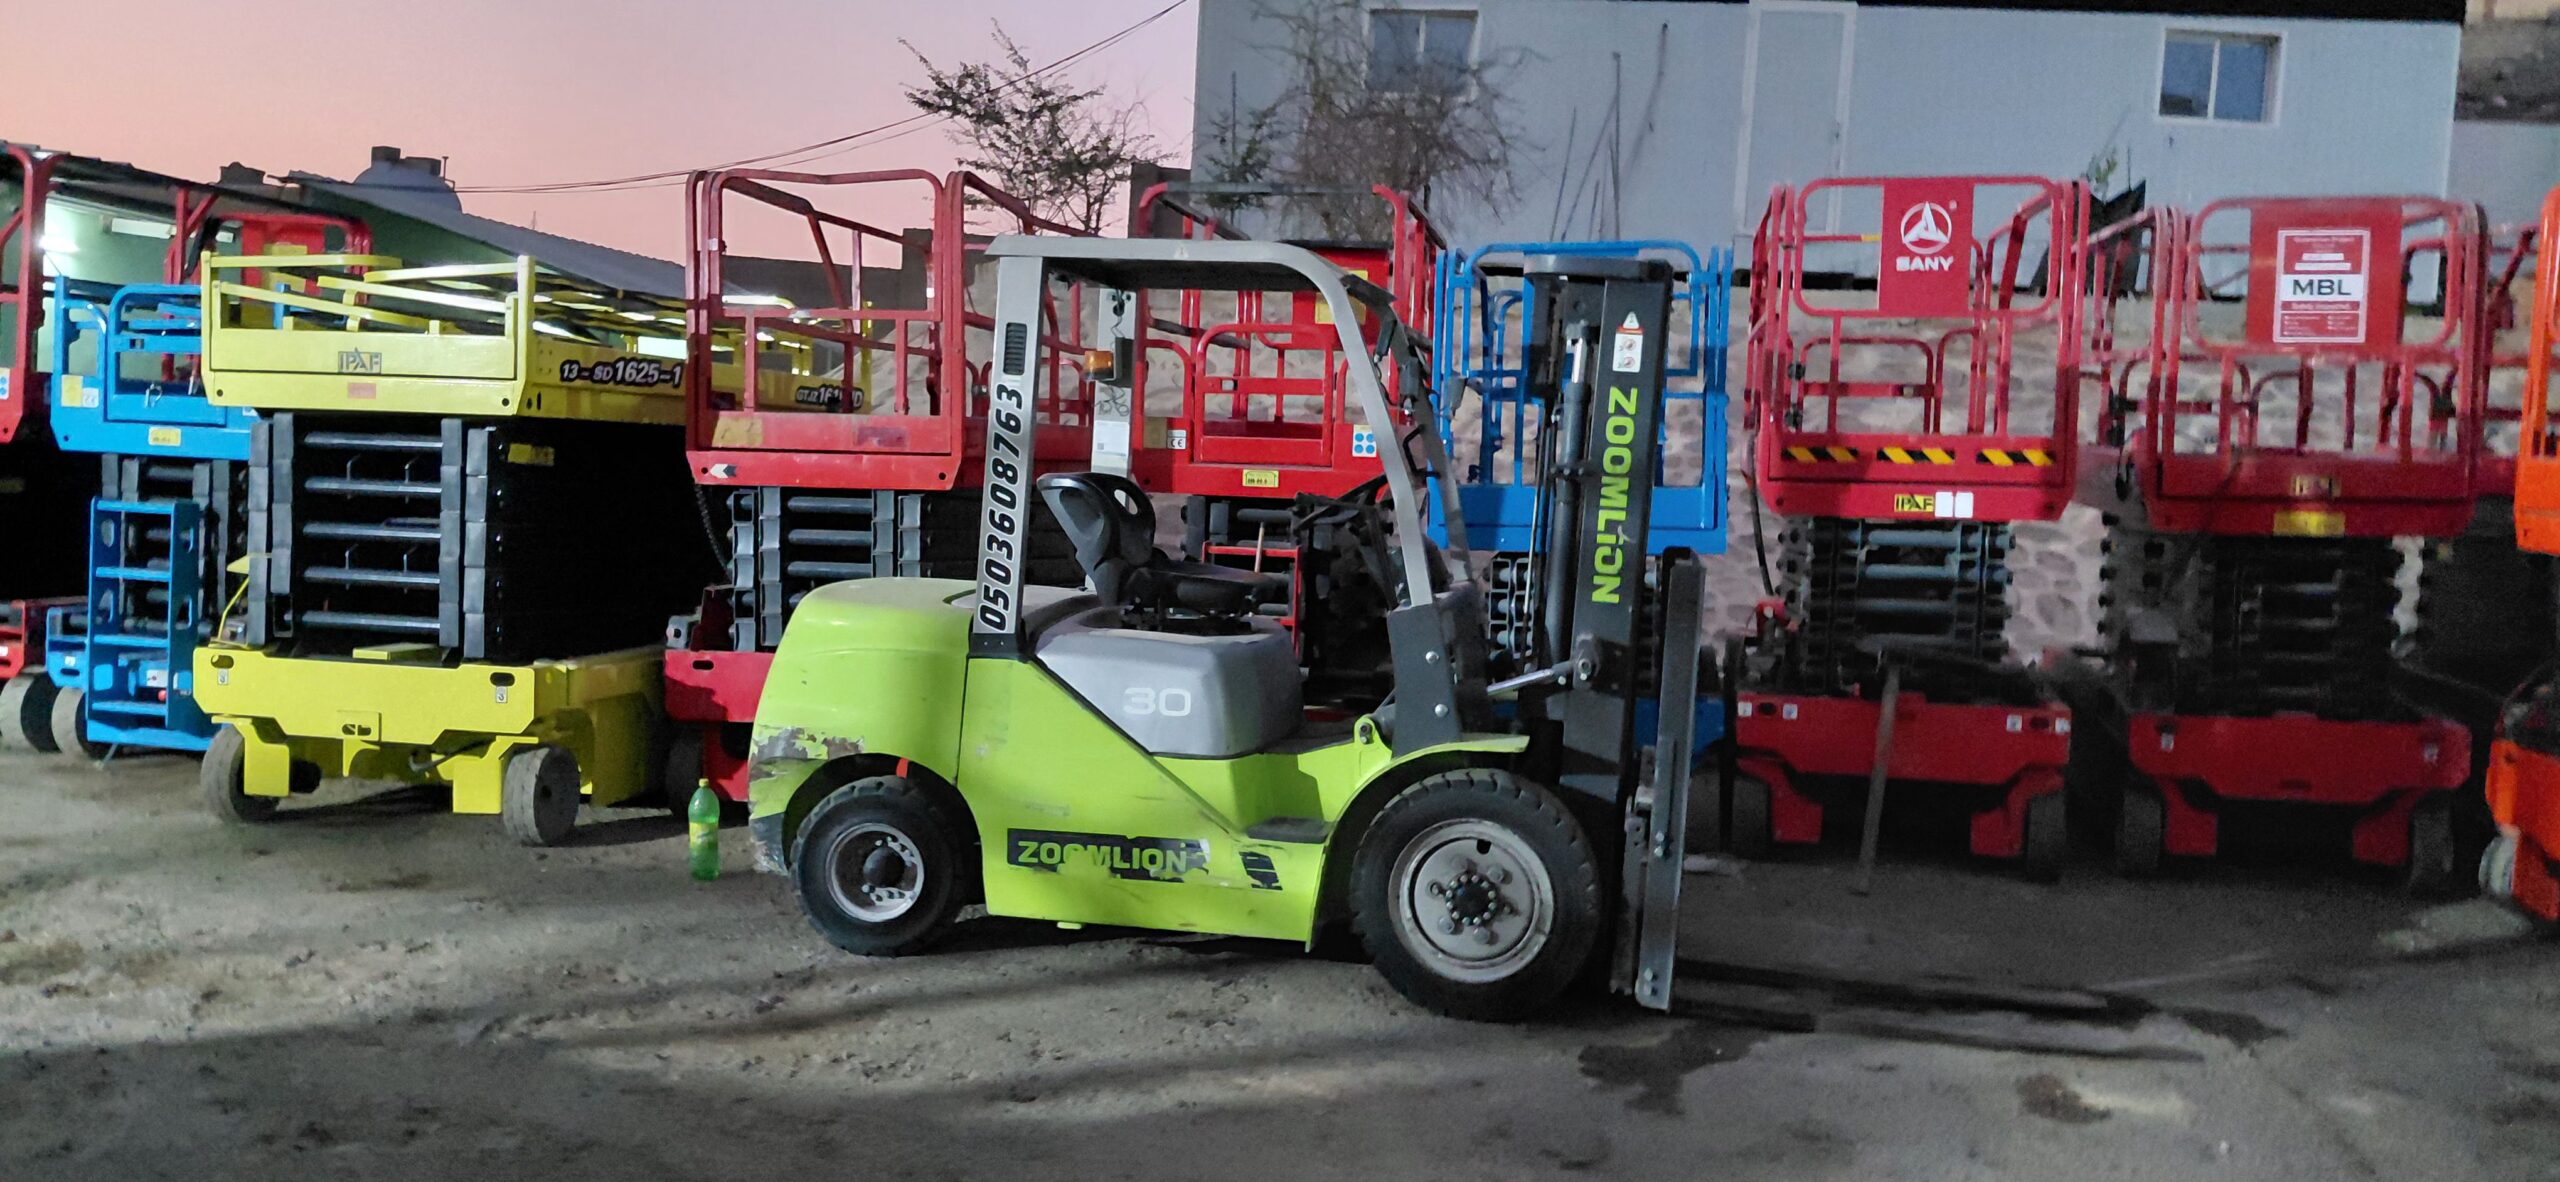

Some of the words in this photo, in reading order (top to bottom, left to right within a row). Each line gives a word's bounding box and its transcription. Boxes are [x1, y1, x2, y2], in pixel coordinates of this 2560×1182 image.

[1896, 255, 1954, 272] SANY
[2292, 279, 2352, 296] MBL
[1591, 386, 1638, 604] ZOOMLION
[1896, 493, 1934, 511] IPAF
[979, 383, 1024, 632] 0503608763
[1123, 687, 1192, 717] 30
